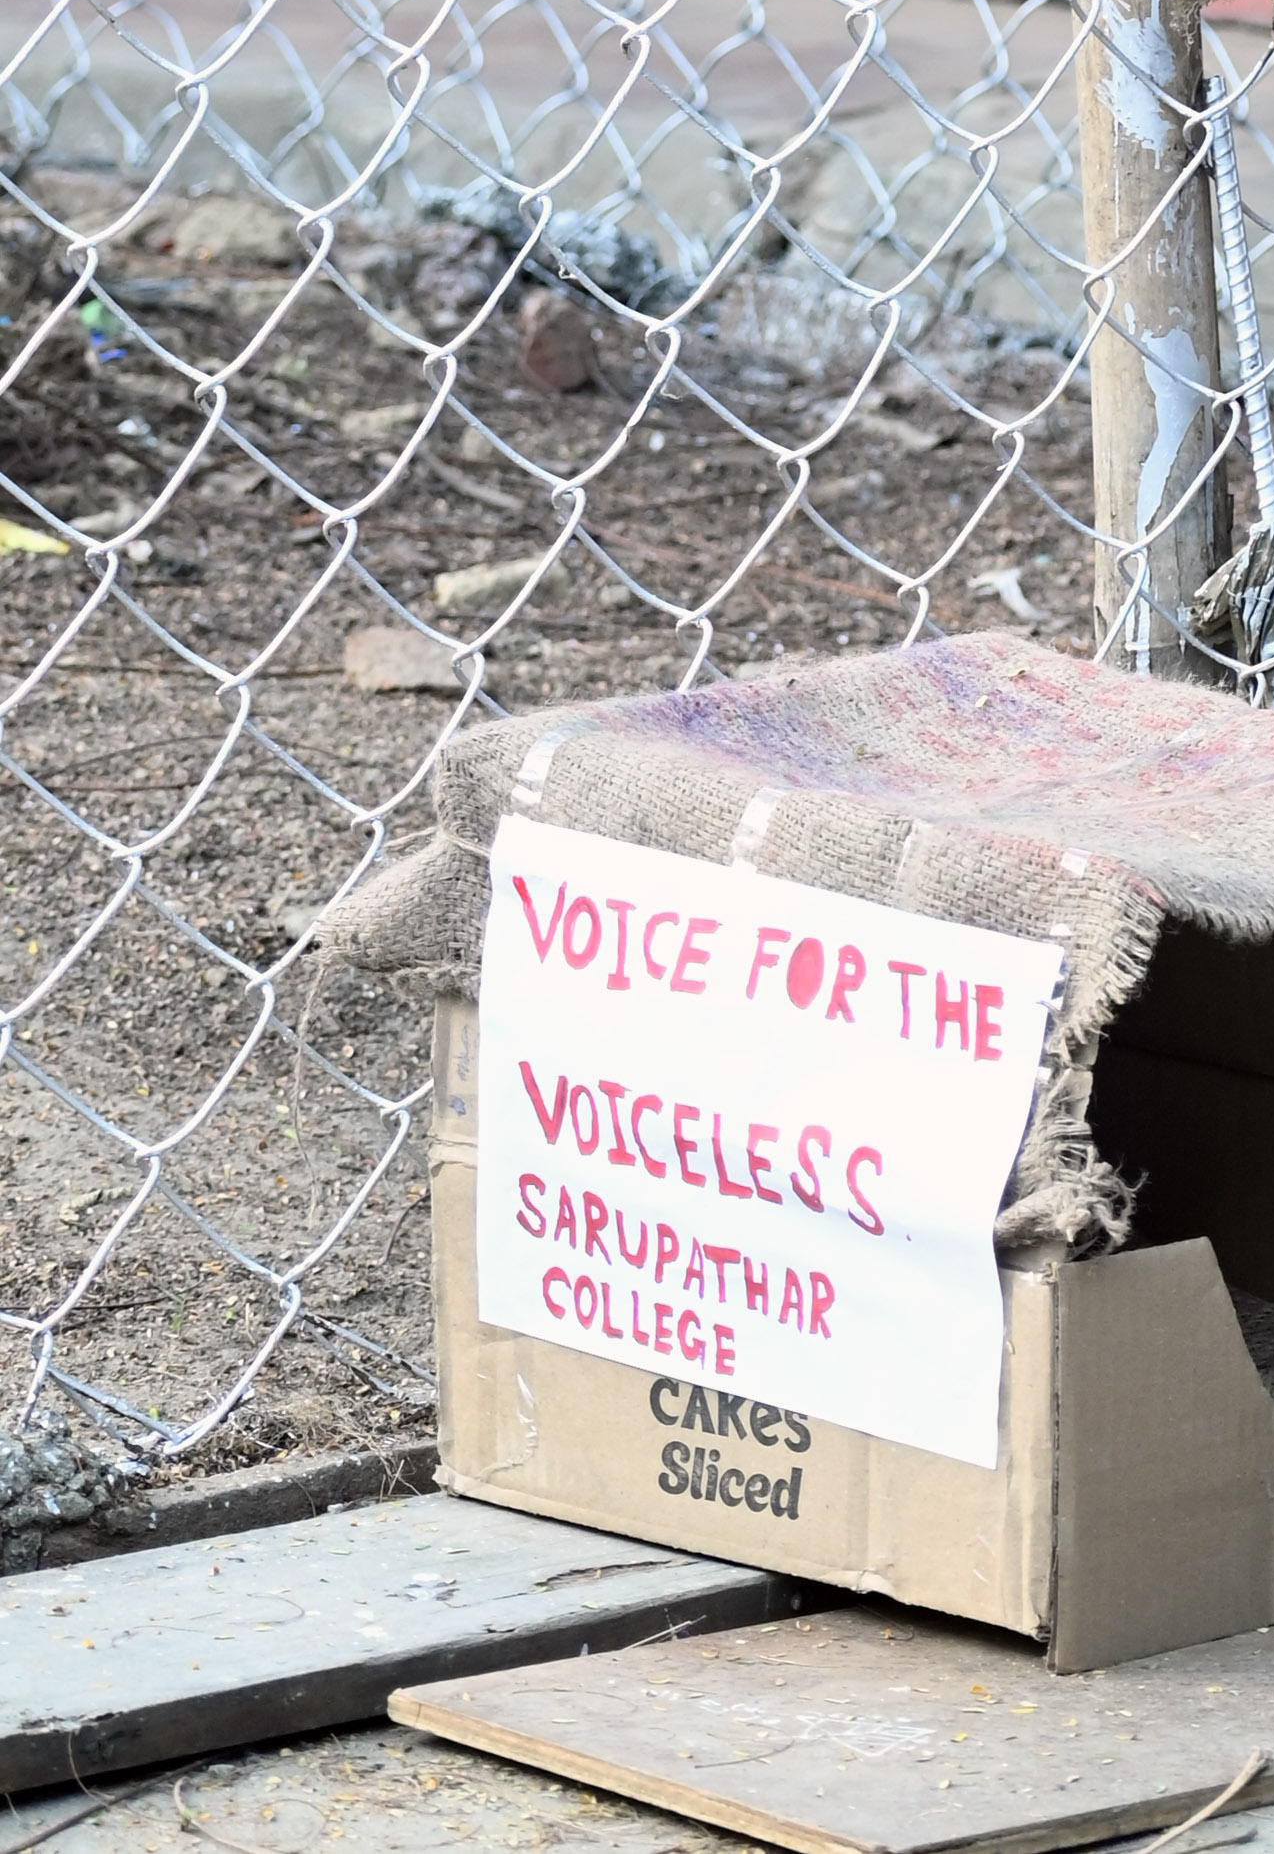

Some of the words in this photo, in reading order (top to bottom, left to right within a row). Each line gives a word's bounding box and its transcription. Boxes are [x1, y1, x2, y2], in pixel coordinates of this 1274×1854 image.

[511, 875, 720, 994] VOICE
[745, 926, 867, 1023] FOR
[889, 959, 1004, 1062] THE
[518, 1061, 885, 1237] VOICELESS
[515, 1173, 836, 1340] SARUPATHAR
[542, 1266, 735, 1376] COLLEGE
[658, 1441, 803, 1521] Sliced
